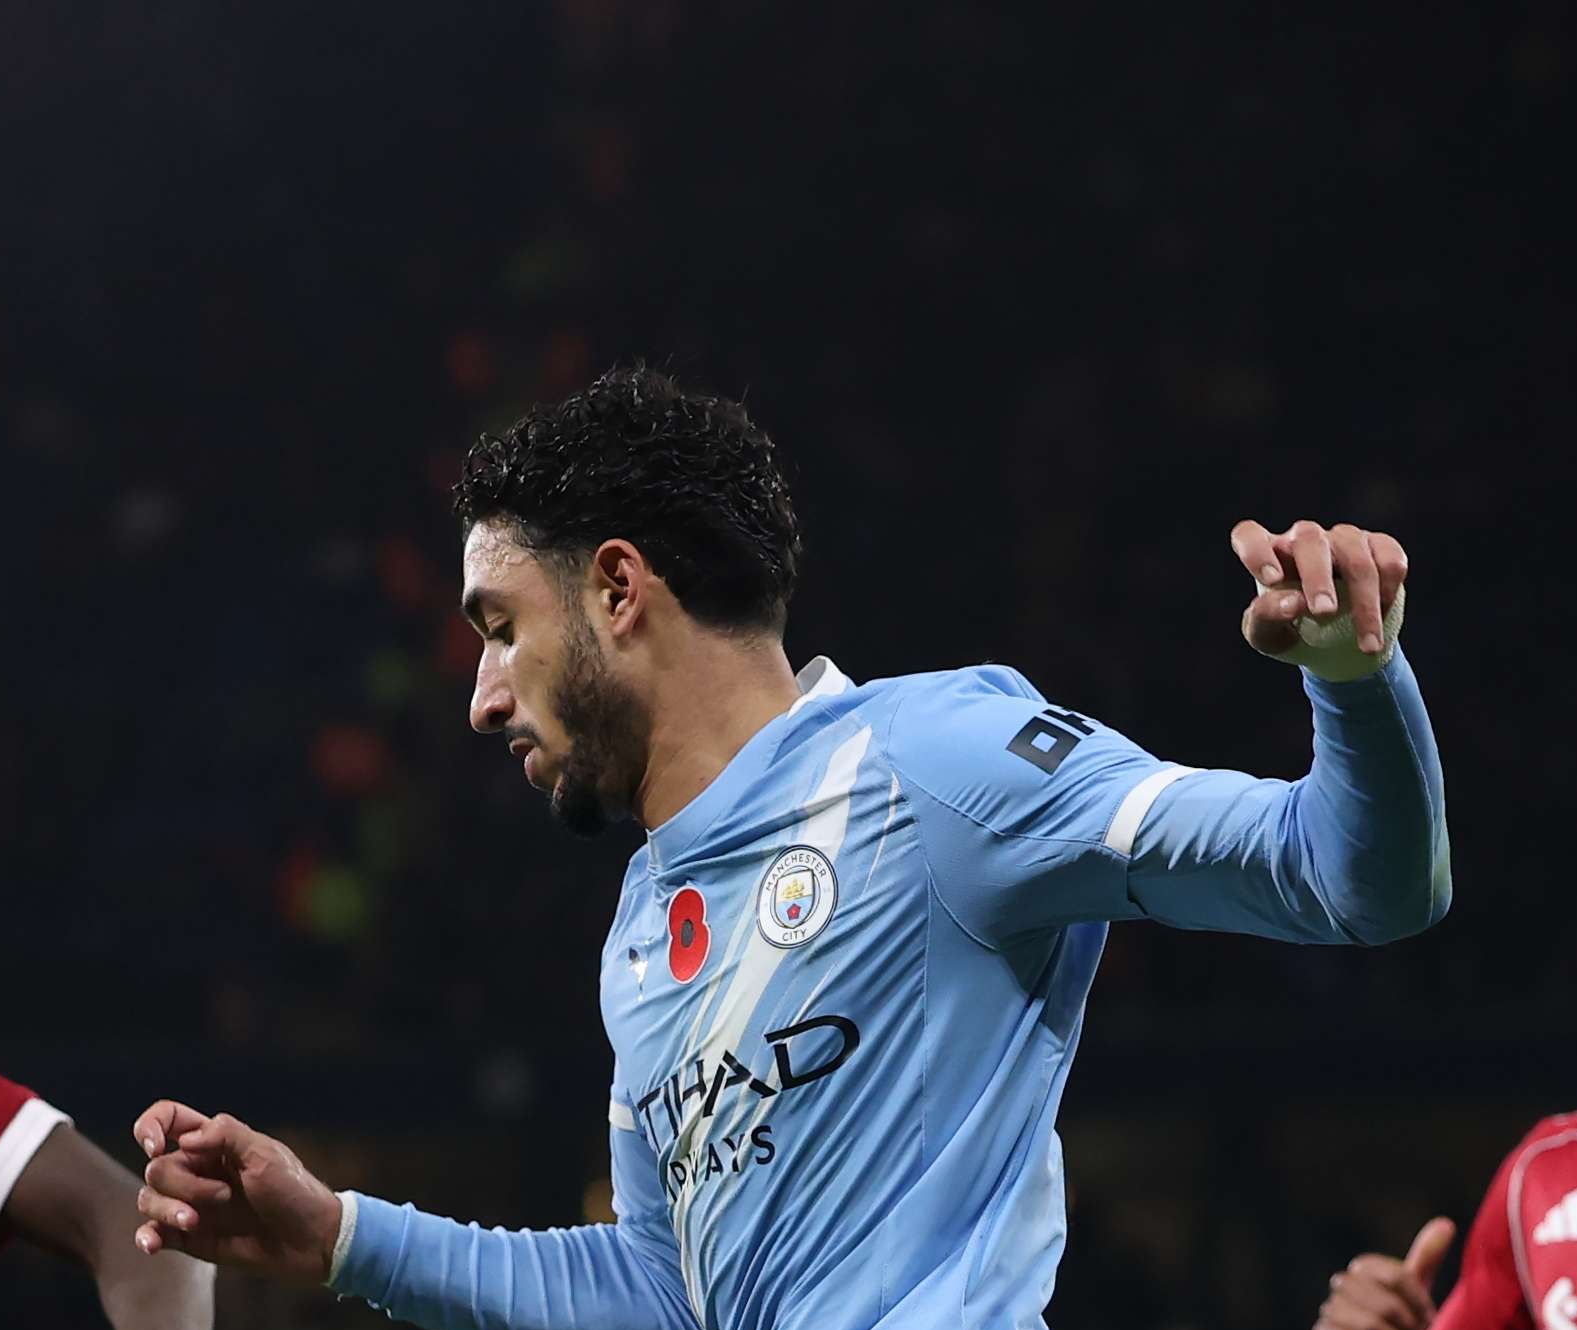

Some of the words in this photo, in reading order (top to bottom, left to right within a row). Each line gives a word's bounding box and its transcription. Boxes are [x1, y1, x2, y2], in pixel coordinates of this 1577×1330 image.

[765, 853, 827, 891] MANCHESTER
[782, 928, 807, 942] CITY
[637, 1015, 861, 1154] TIHAD
